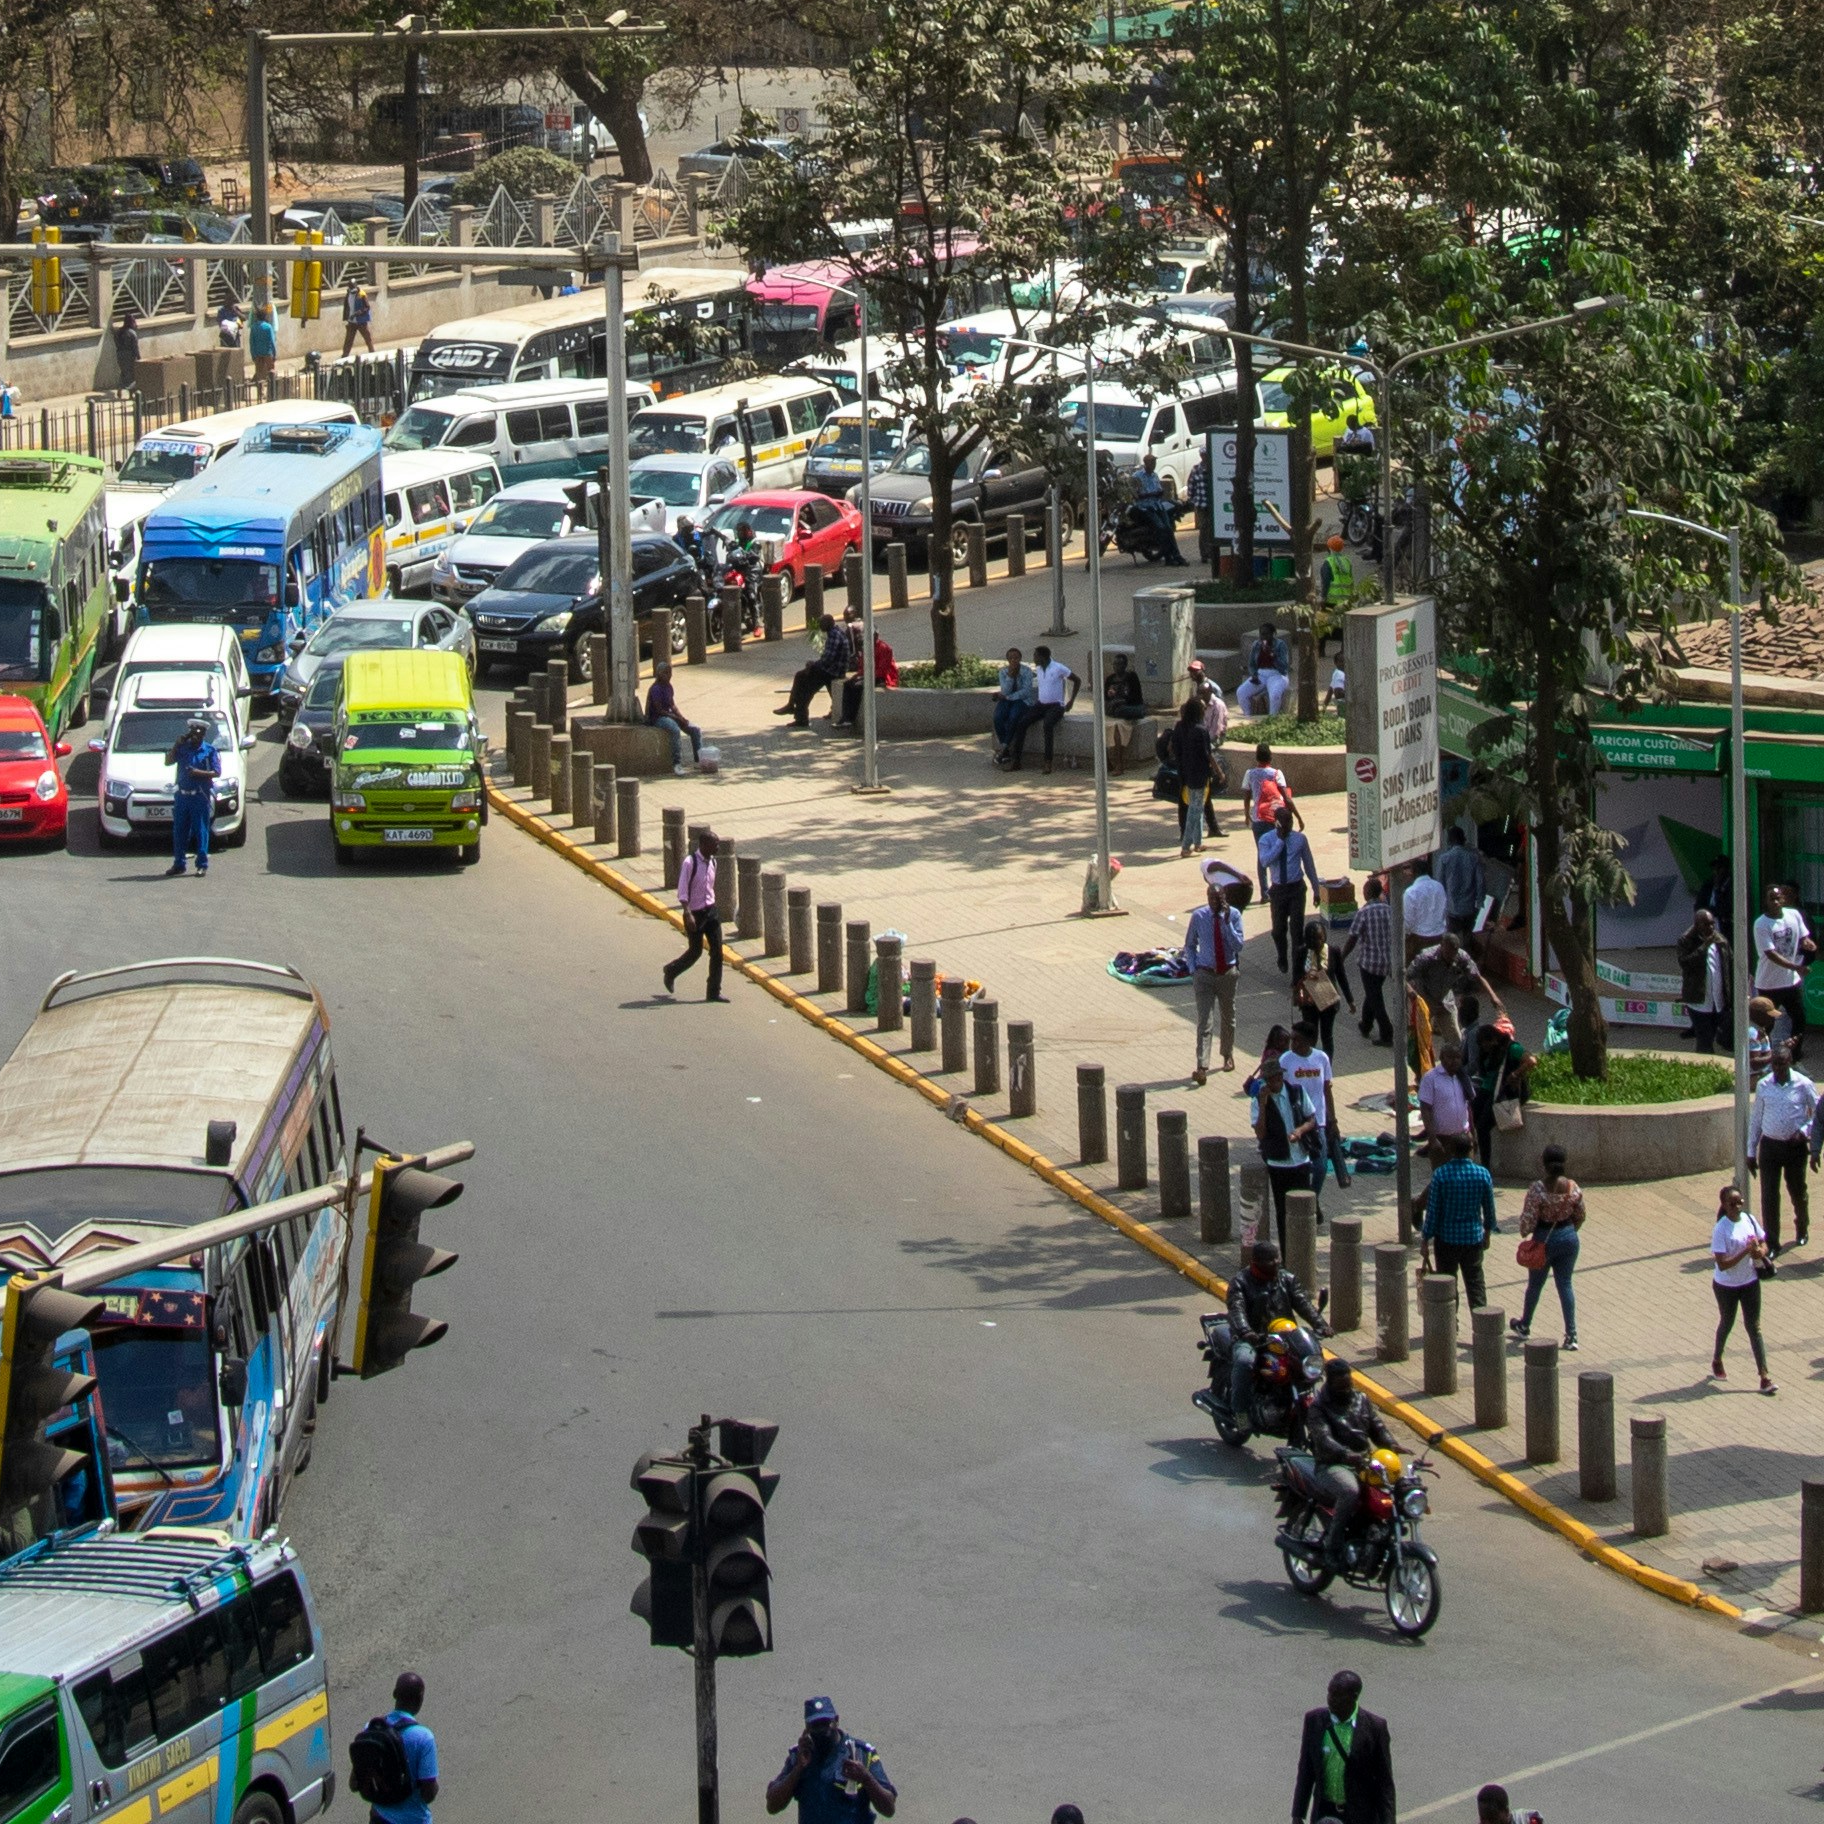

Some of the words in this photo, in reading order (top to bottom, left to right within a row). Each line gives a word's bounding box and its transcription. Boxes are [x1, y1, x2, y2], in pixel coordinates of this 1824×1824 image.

[440, 347, 483, 368] AND
[1378, 651, 1435, 684] PROGRESSIVE
[1391, 673, 1423, 697] CREDIT
[1382, 705, 1407, 731] BODA
[1408, 694, 1432, 722] BODA
[1393, 721, 1423, 750] LOANS
[1591, 735, 1641, 749] FARICOM
[1606, 751, 1635, 764] CARE
[1637, 753, 1677, 767] CENTER
[1382, 771, 1405, 800] SMS
[1412, 760, 1436, 790] CALL
[385, 829, 403, 840] KAT
[407, 829, 433, 840] 469D
[1616, 1000, 1657, 1014] NEON
[165, 1736, 192, 1772] SACCO
